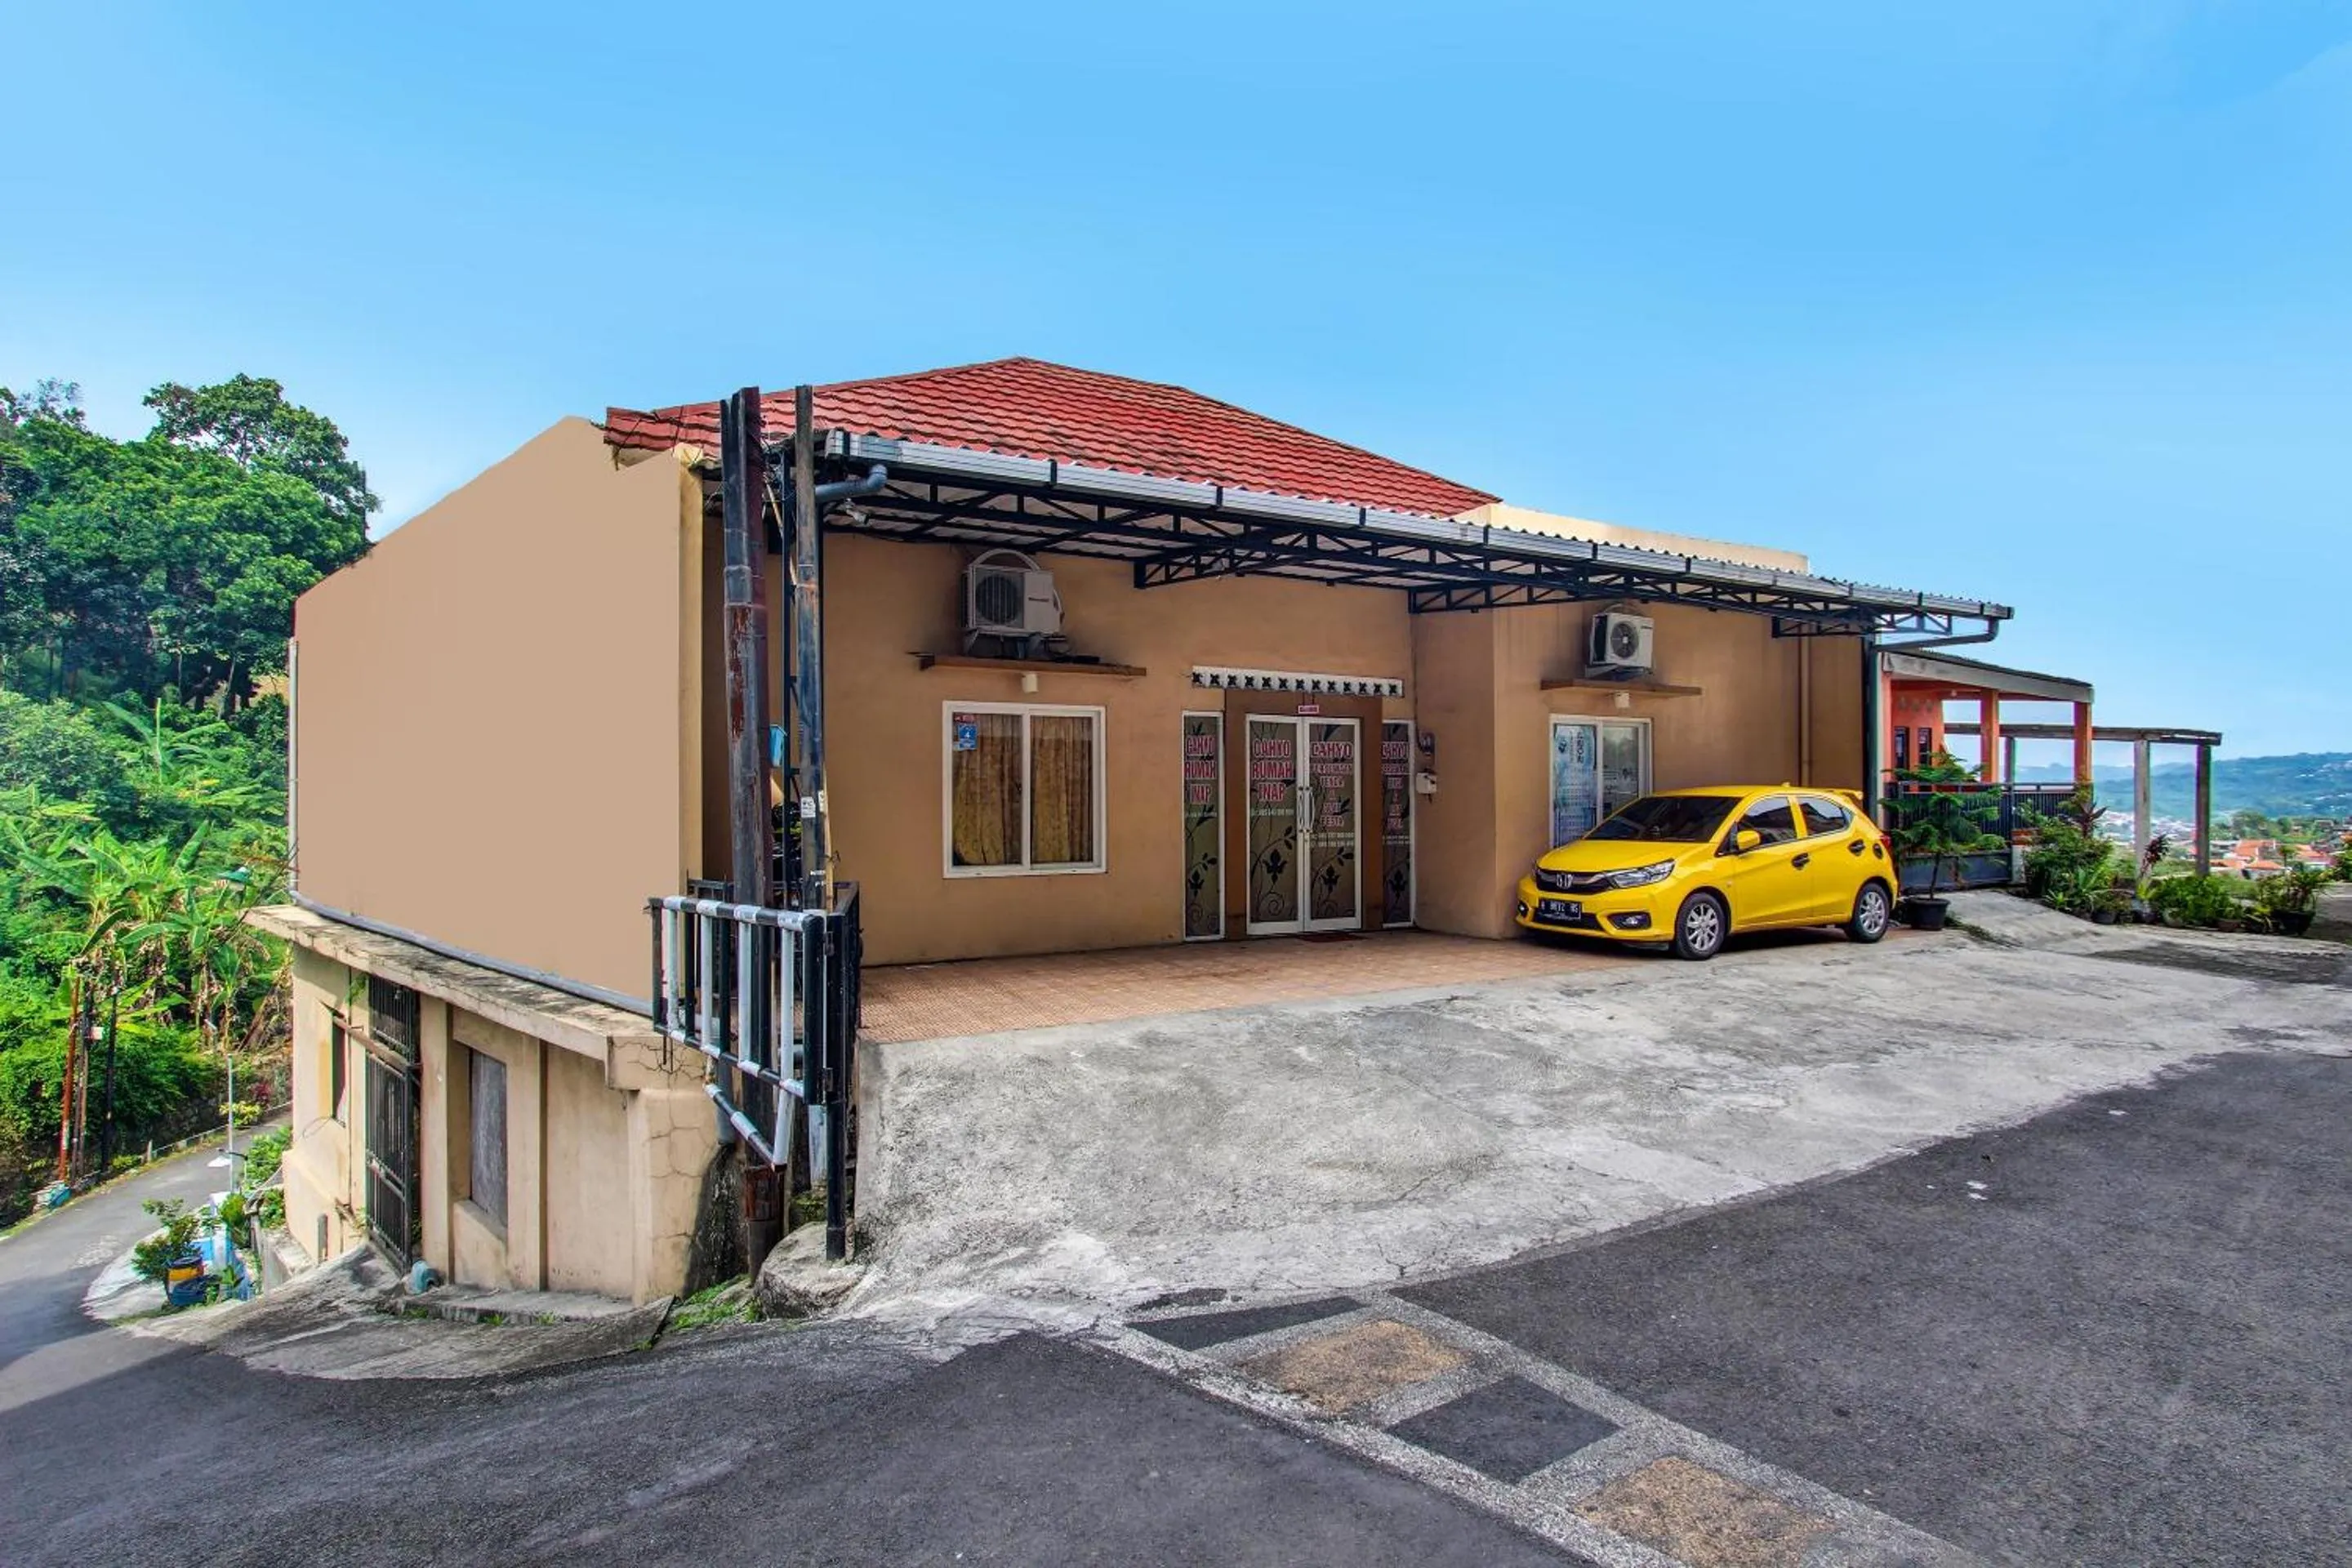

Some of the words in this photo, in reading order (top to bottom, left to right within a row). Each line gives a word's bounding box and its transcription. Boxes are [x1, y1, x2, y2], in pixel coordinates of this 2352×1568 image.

[1253, 739, 1291, 758] CAHYO
[1311, 742, 1353, 759] CAHYO
[1185, 762, 1216, 779] RUMAH
[1252, 761, 1293, 779] RUMAH
[1258, 782, 1286, 801] INAP
